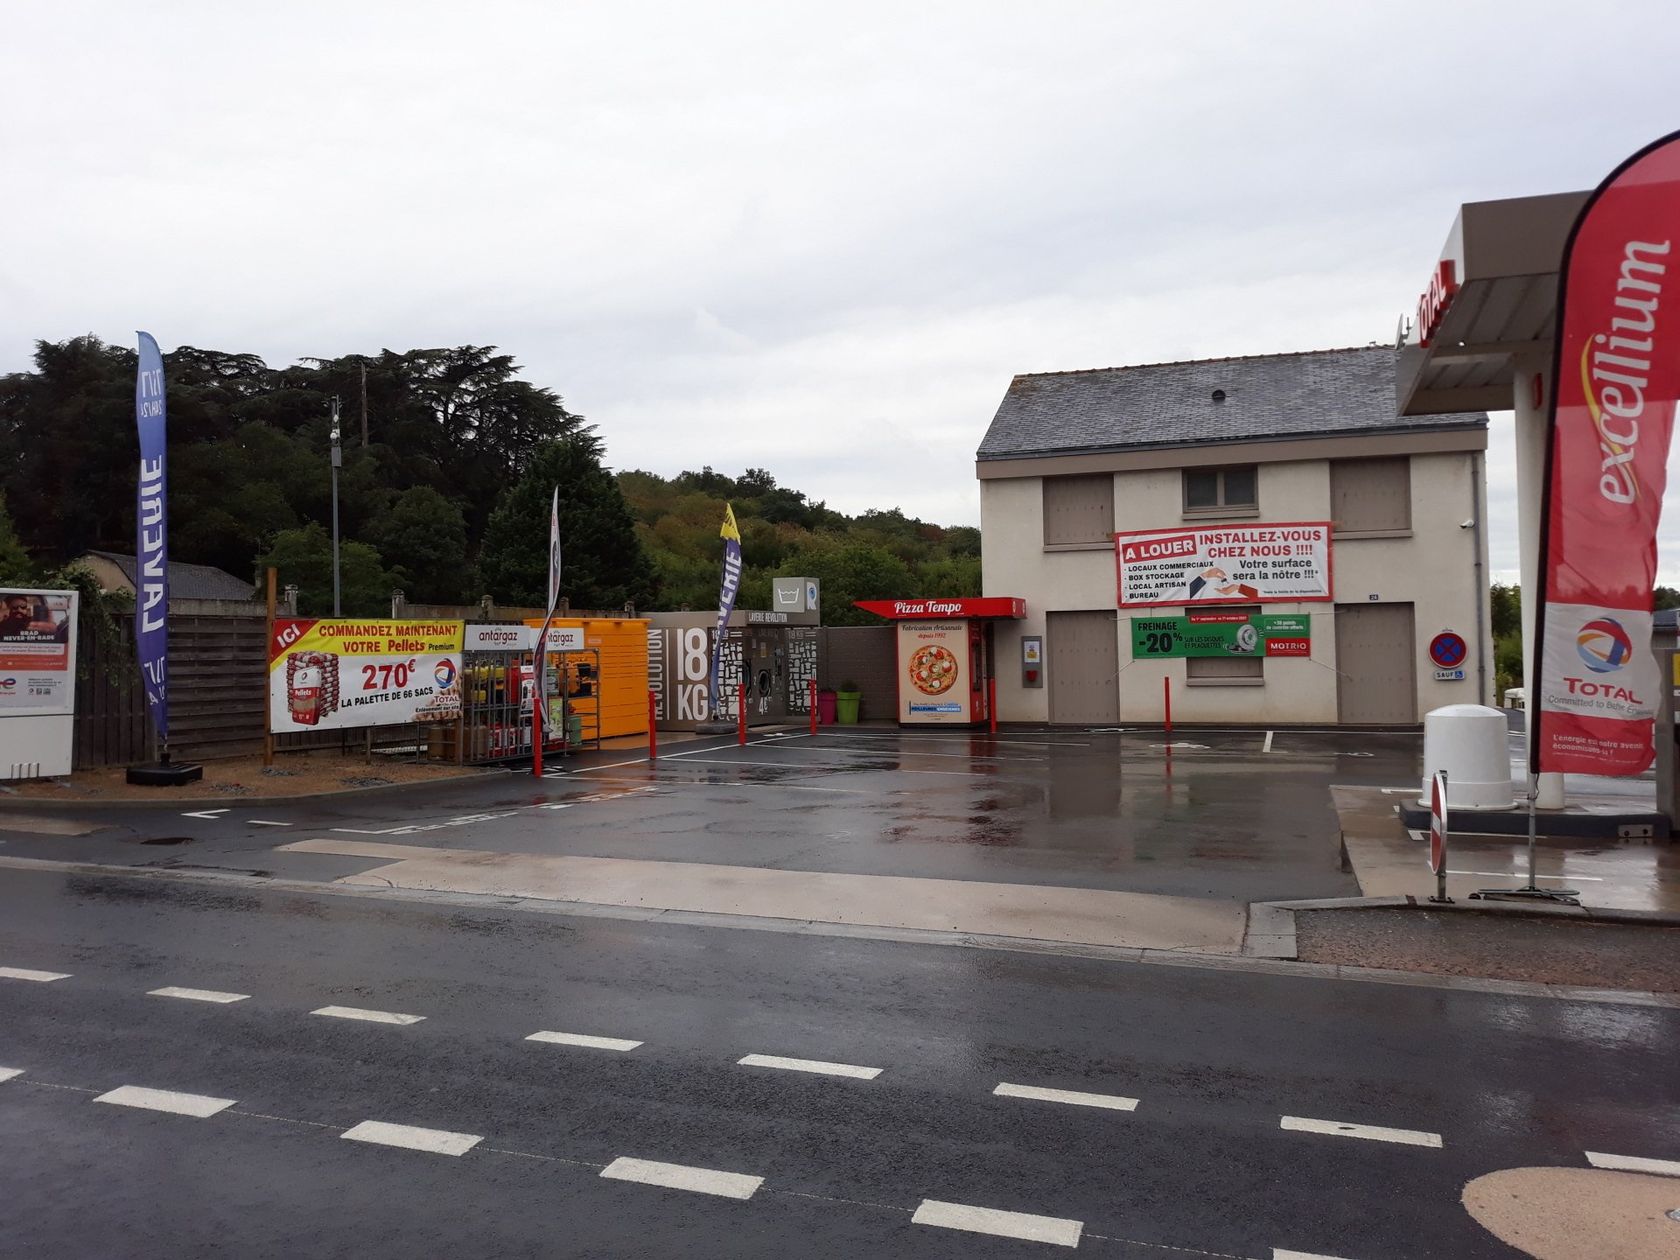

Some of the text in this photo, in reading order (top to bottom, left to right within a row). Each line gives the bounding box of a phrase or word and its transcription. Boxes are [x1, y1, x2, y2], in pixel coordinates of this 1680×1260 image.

[1593, 240, 1671, 504] excellium
[1200, 530, 1322, 545] INSTALLEZ-VOUS
[1125, 539, 1194, 560] A LOUER
[1208, 544, 1313, 558] CHEZ NOUS !!!!
[1128, 561, 1214, 572] LOCAUX COMMERCIAUX
[1239, 558, 1312, 569] Votre surface
[1128, 572, 1185, 581] BOX STOCKAGE
[1232, 572, 1256, 581] sera
[1259, 570, 1268, 580] la
[1272, 568, 1301, 580] nôtre
[718, 552, 742, 628] AVERIE
[1154, 581, 1186, 589] ARTISAN
[1129, 592, 1159, 600] BUREAU
[894, 600, 962, 616] Pizza Tempo
[319, 625, 458, 637] COMMANDEZ MAINTENANT
[1138, 622, 1176, 631] FREINAGE
[276, 624, 300, 648] ICI
[479, 630, 518, 645] antargaz
[548, 633, 573, 647] targaz
[343, 641, 380, 653] VOTRE
[388, 639, 426, 651] Pellets
[677, 627, 707, 681] 18
[341, 686, 433, 708] LA PALETTE DE 66 SACS
[1563, 676, 1644, 704] TOTAL
[678, 684, 709, 721] KG
[1548, 695, 1594, 708] Committed
[1596, 700, 1604, 708] to
